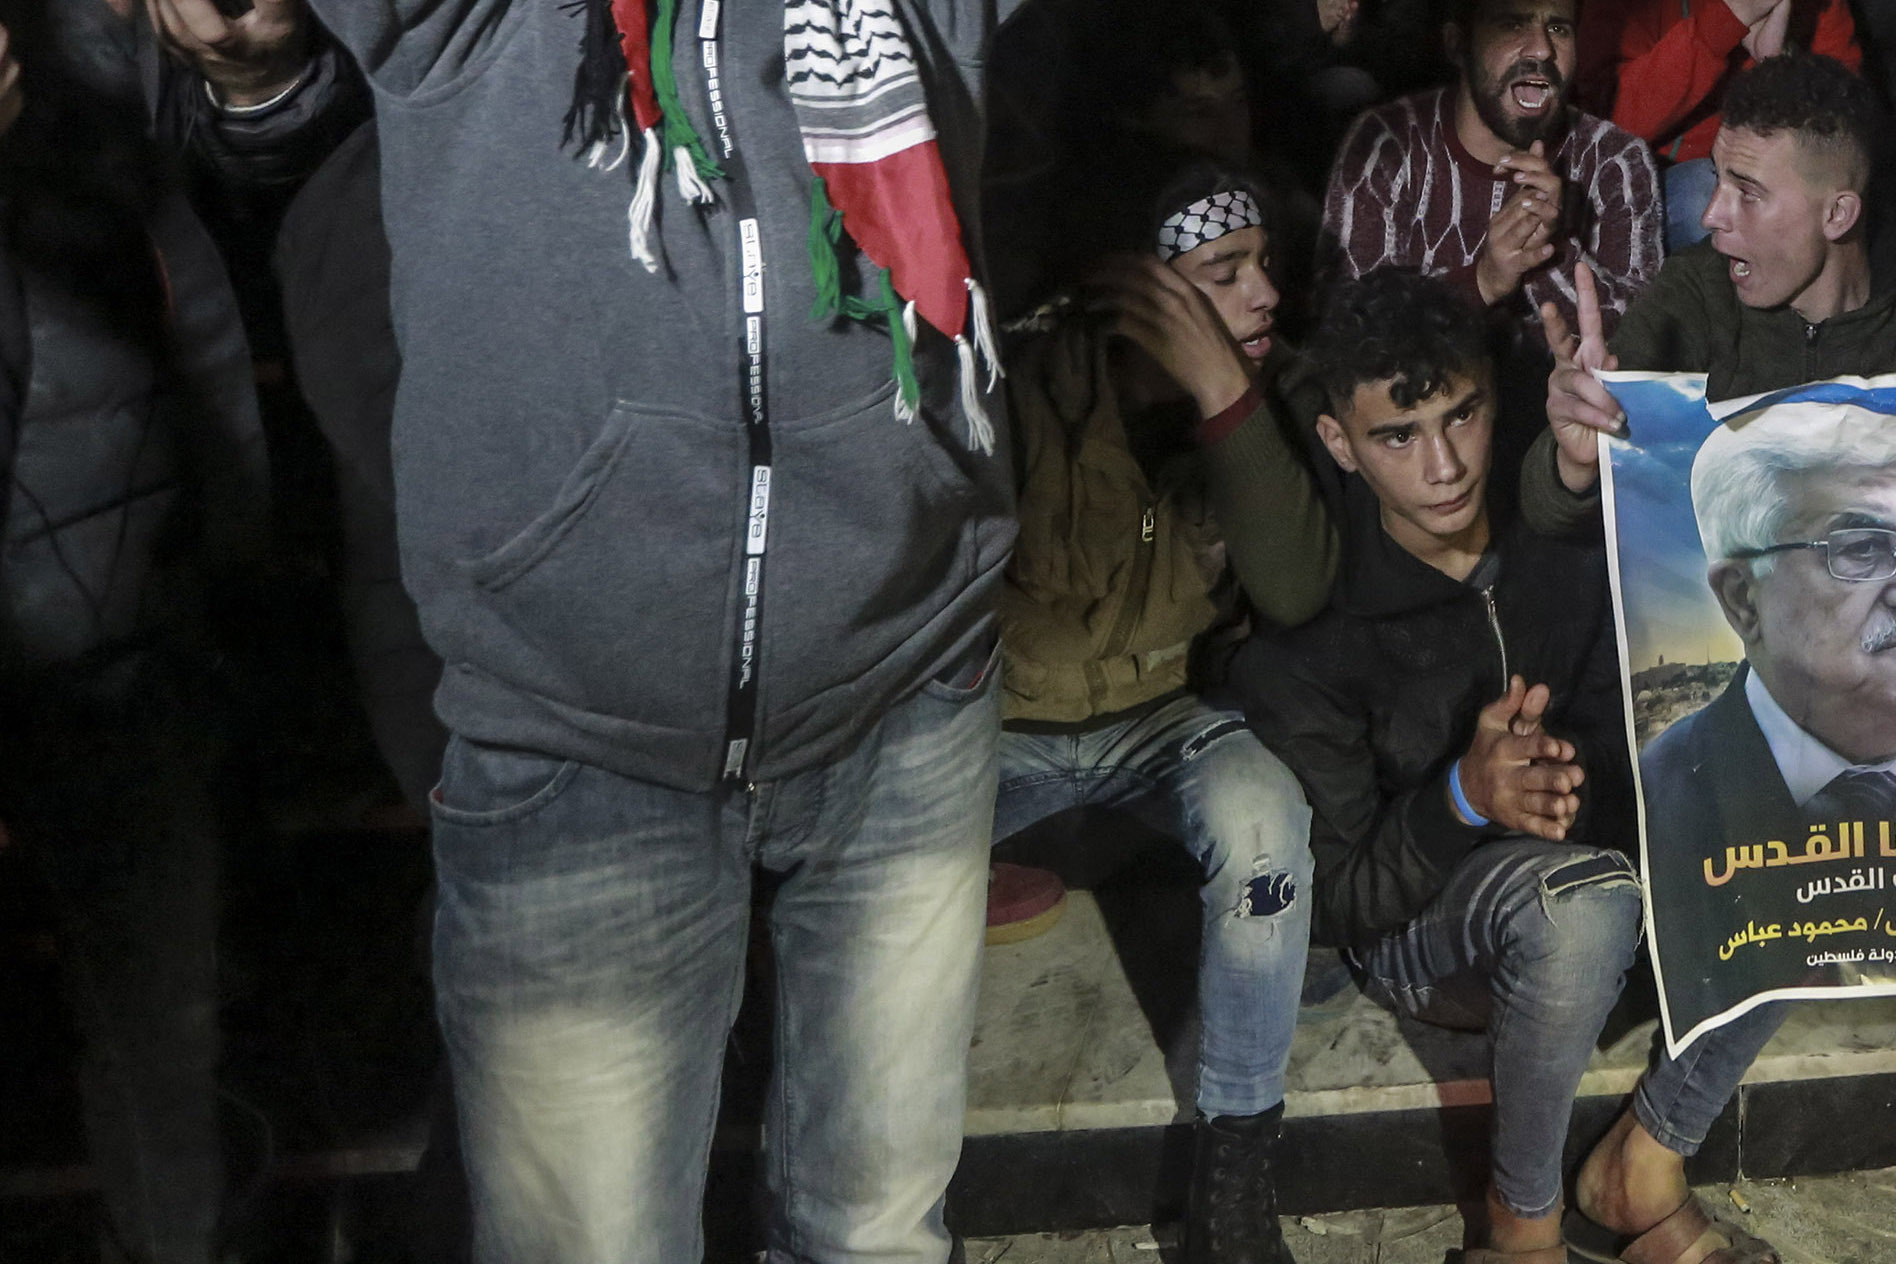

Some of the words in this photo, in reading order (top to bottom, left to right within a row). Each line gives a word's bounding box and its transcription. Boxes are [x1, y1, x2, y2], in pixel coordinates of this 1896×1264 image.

[739, 560, 759, 690] PROFESSIONAL
[1703, 821, 1866, 887] القدس
[1796, 867, 1884, 903] القدس
[1718, 920, 1782, 961] عباس
[1788, 915, 1867, 943] محمود
[1806, 947, 1865, 967] فلسطين
